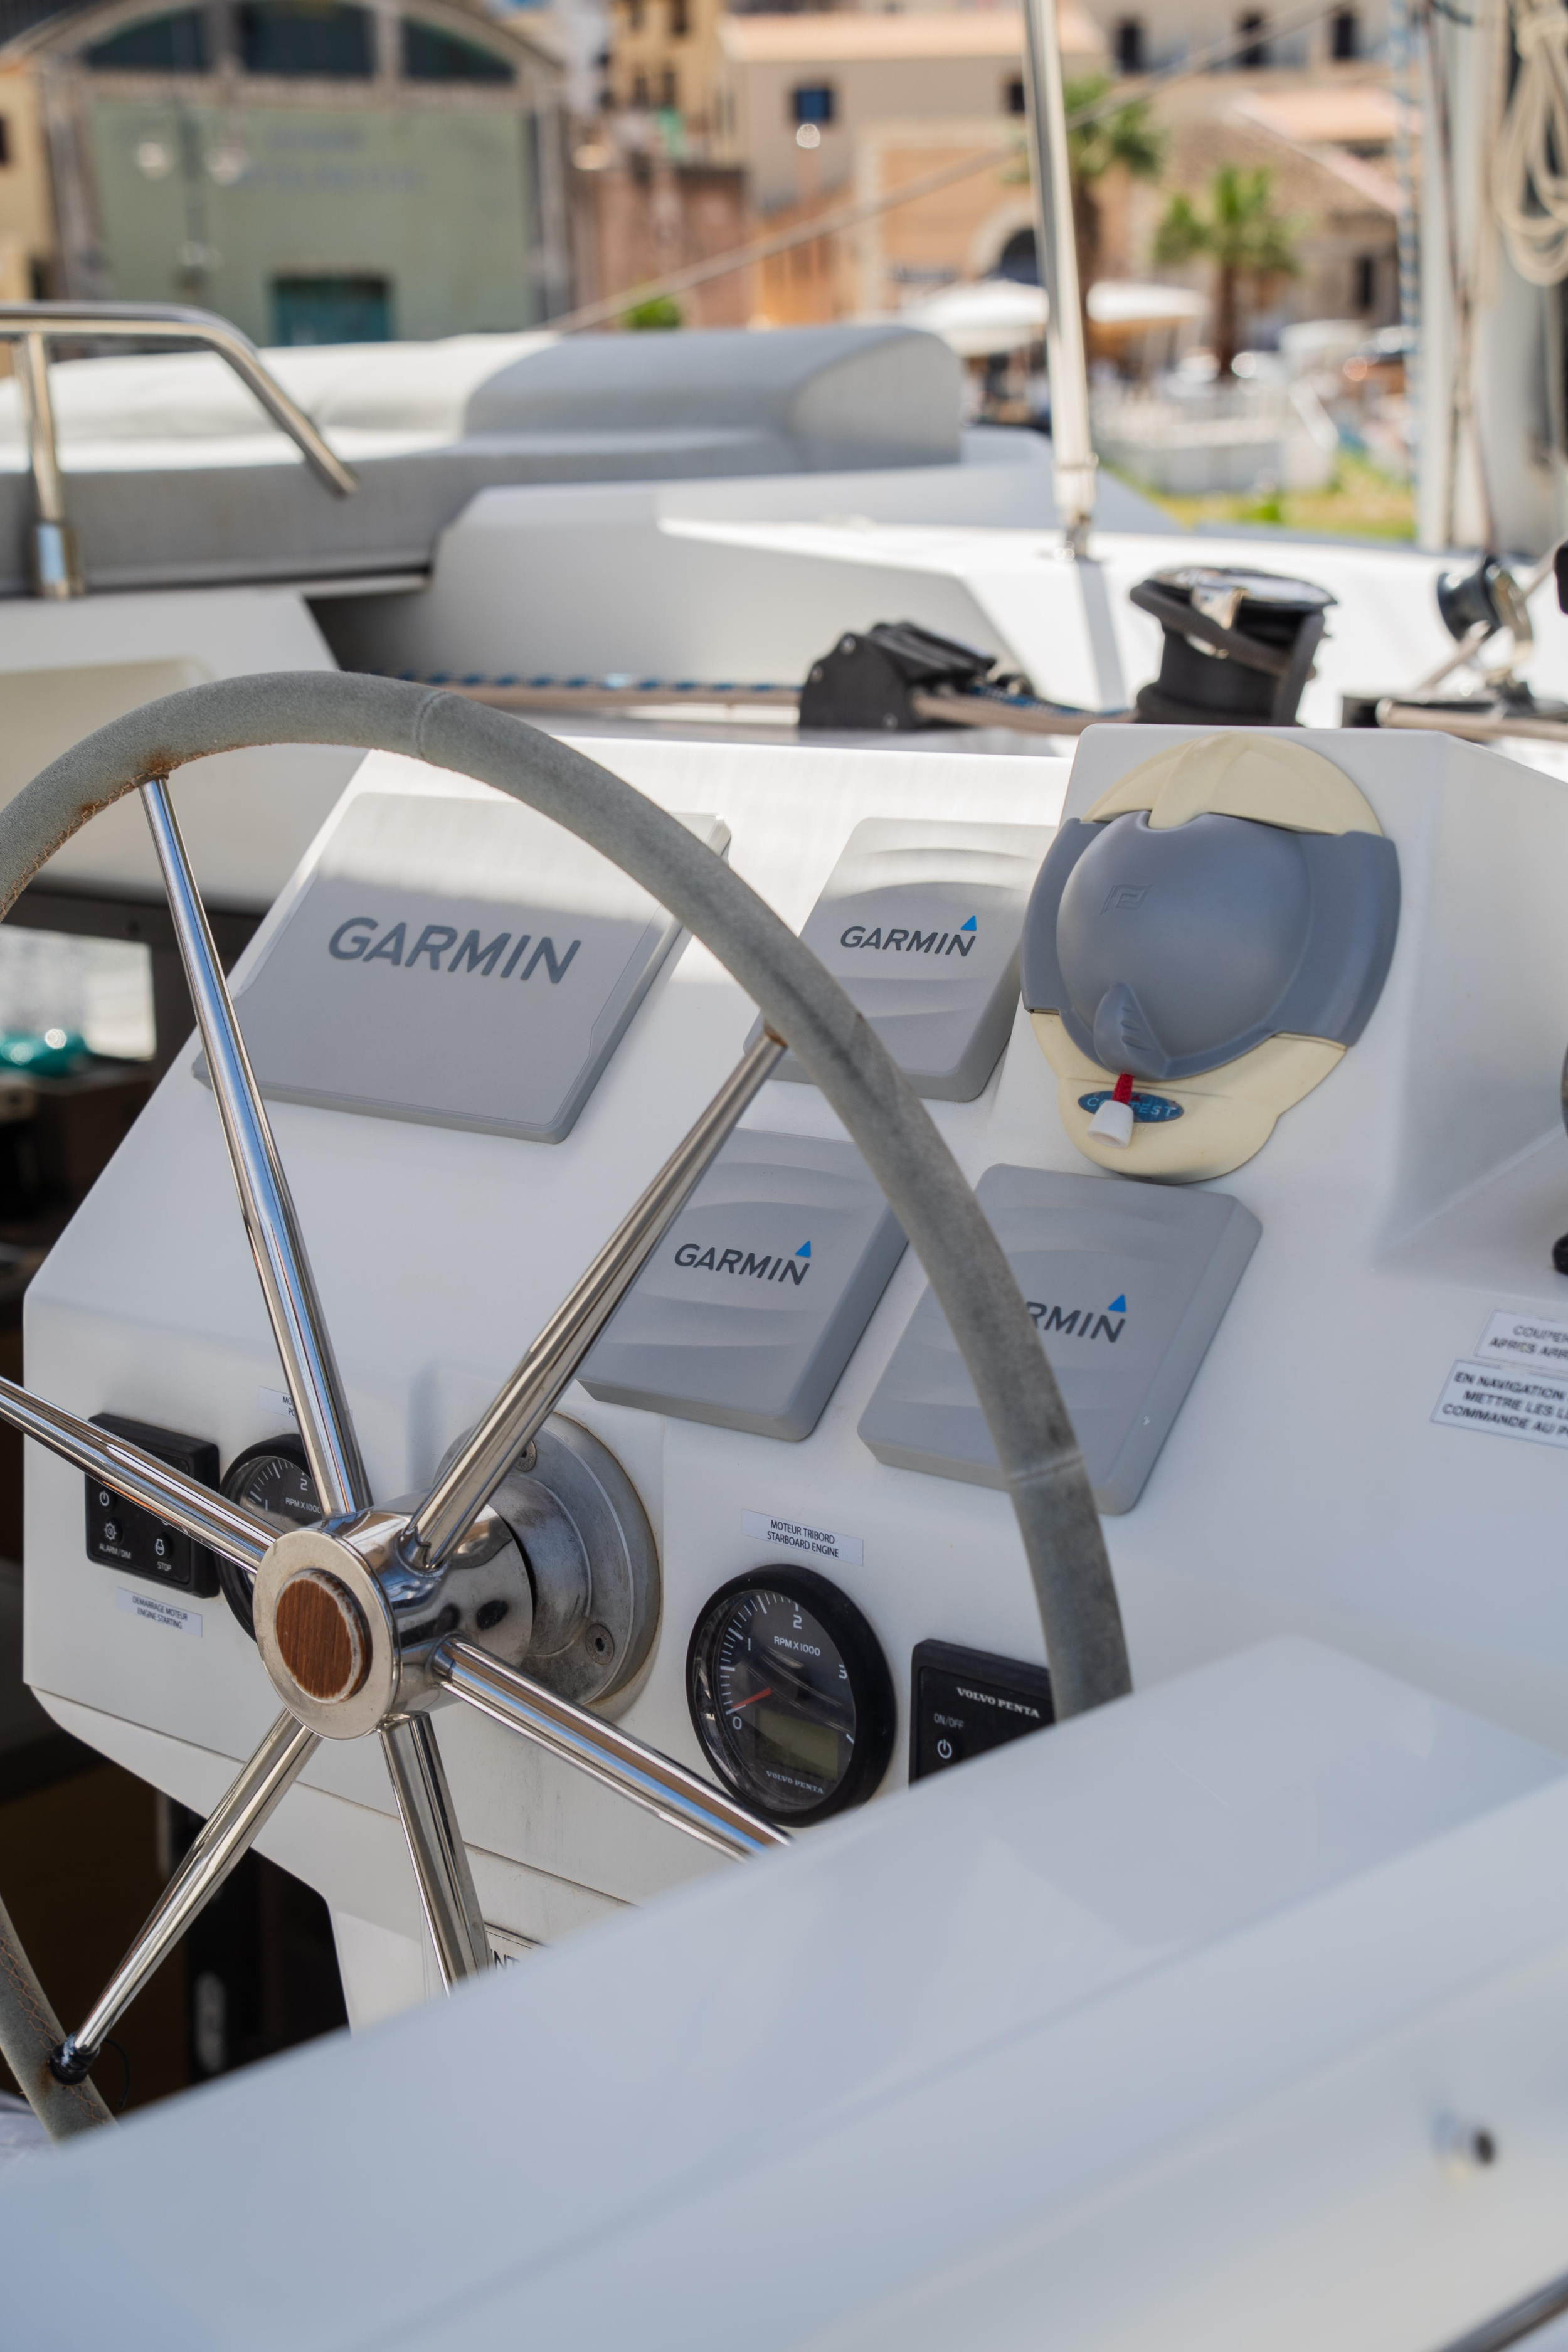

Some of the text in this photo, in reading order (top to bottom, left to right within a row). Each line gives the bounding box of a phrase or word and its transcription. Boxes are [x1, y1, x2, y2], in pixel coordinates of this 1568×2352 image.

[328, 916, 582, 985] GARMIN
[840, 926, 977, 957] GARMIN
[1086, 1097, 1177, 1118] CTEST
[674, 1243, 810, 1286] GARMIN
[1026, 1301, 1126, 1343] RMIN
[1454, 1371, 1475, 1385] EN
[1477, 1376, 1564, 1400] NAVIGATION
[1463, 1390, 1522, 1410] METTRE
[1525, 1402, 1554, 1416] LES
[1442, 1403, 1528, 1429] COMMANDE
[1532, 1421, 1555, 1434] AU
[300, 1477, 308, 1491] 2
[285, 1497, 300, 1508] RPM
[770, 1519, 835, 1545] MOTEUR TRIBORD
[98, 1542, 132, 1559] ALARM/DIM
[767, 1530, 839, 1559] STARBOARD ENGINE
[157, 1561, 172, 1572] STOP
[132, 1595, 188, 1621] DEMARRAGE MOTEUR
[137, 1607, 183, 1630] ENGINE STARTING
[793, 1614, 802, 1629] 2
[774, 1635, 821, 1656] RPM X 1000
[838, 1663, 848, 1680] 3
[956, 1686, 1041, 1719] VOLVO PENTA
[732, 1715, 743, 1730] 0
[933, 1712, 965, 1729] ON/OFF
[765, 1770, 824, 1794] VOLVO PENTA
